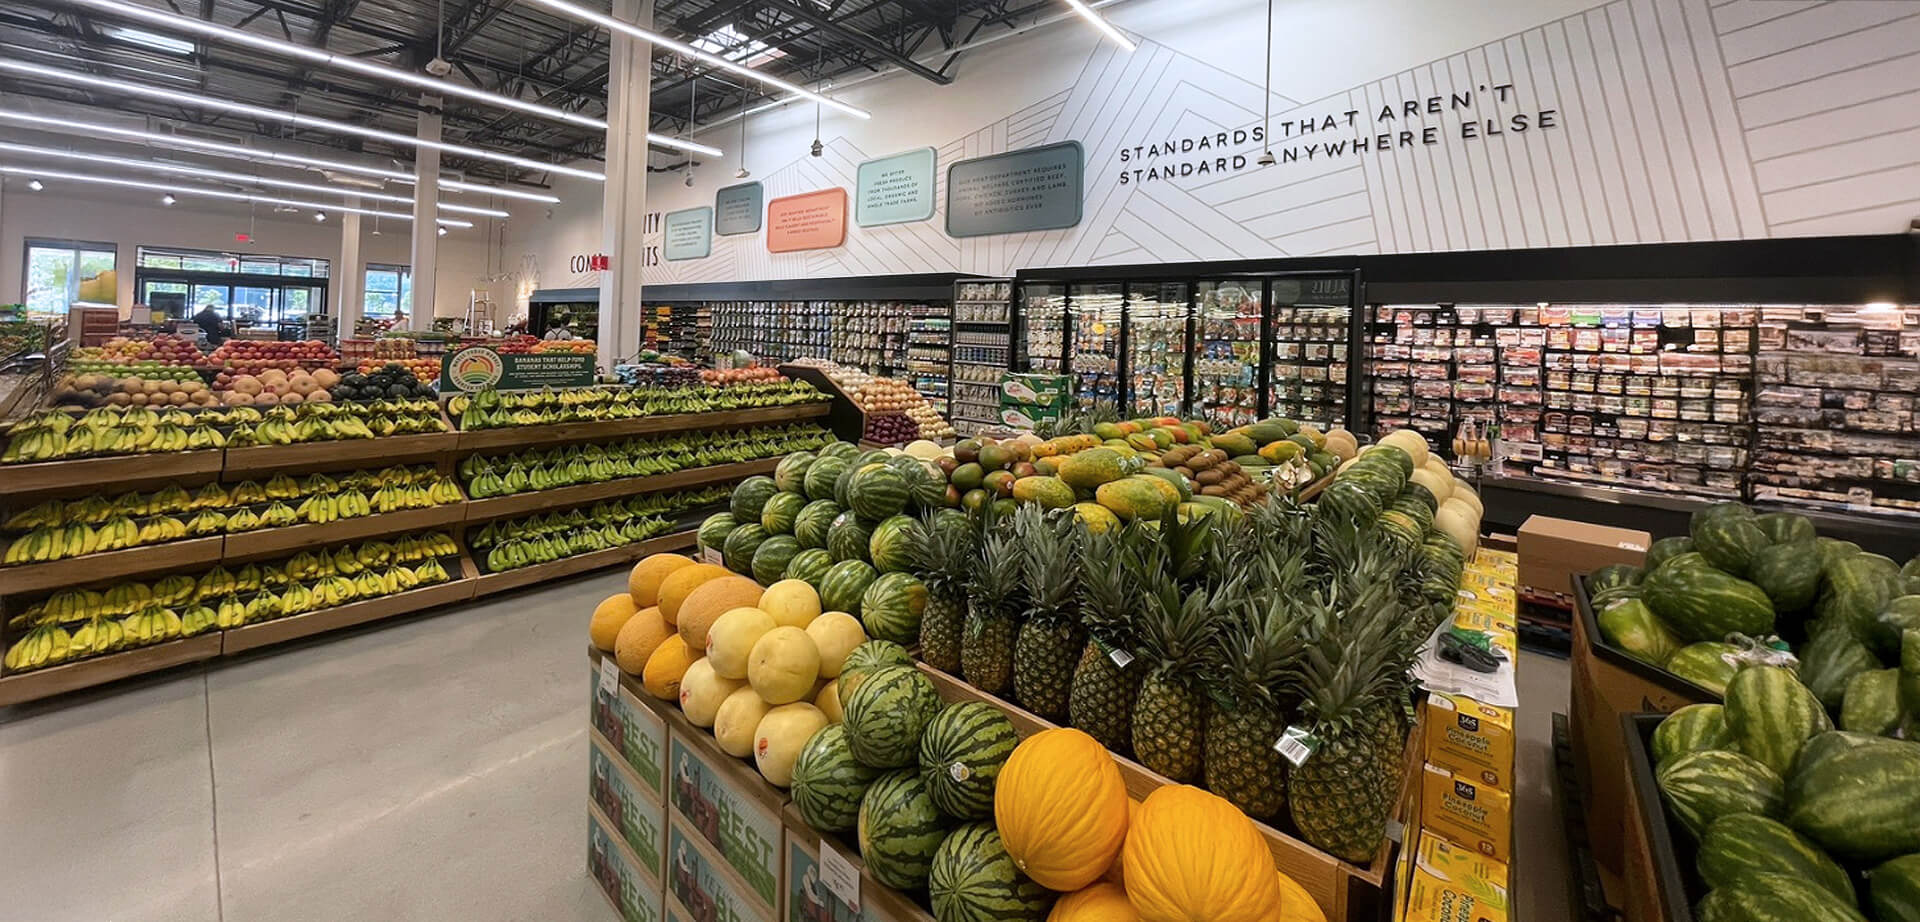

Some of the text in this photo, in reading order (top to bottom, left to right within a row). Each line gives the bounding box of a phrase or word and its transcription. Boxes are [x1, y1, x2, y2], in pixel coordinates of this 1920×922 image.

[1119, 154, 1247, 185] STANDARD
[1461, 109, 1558, 140] ELSE
[1120, 84, 1513, 163] STANDARDS THAT AREN'T
[622, 714, 660, 763] BEST
[1448, 734, 1488, 751] Coconut
[1460, 716, 1477, 728] 365
[1444, 800, 1485, 821] Coconut
[1456, 782, 1474, 795] 365
[621, 796, 658, 849] BEST
[718, 798, 774, 870] BEST
